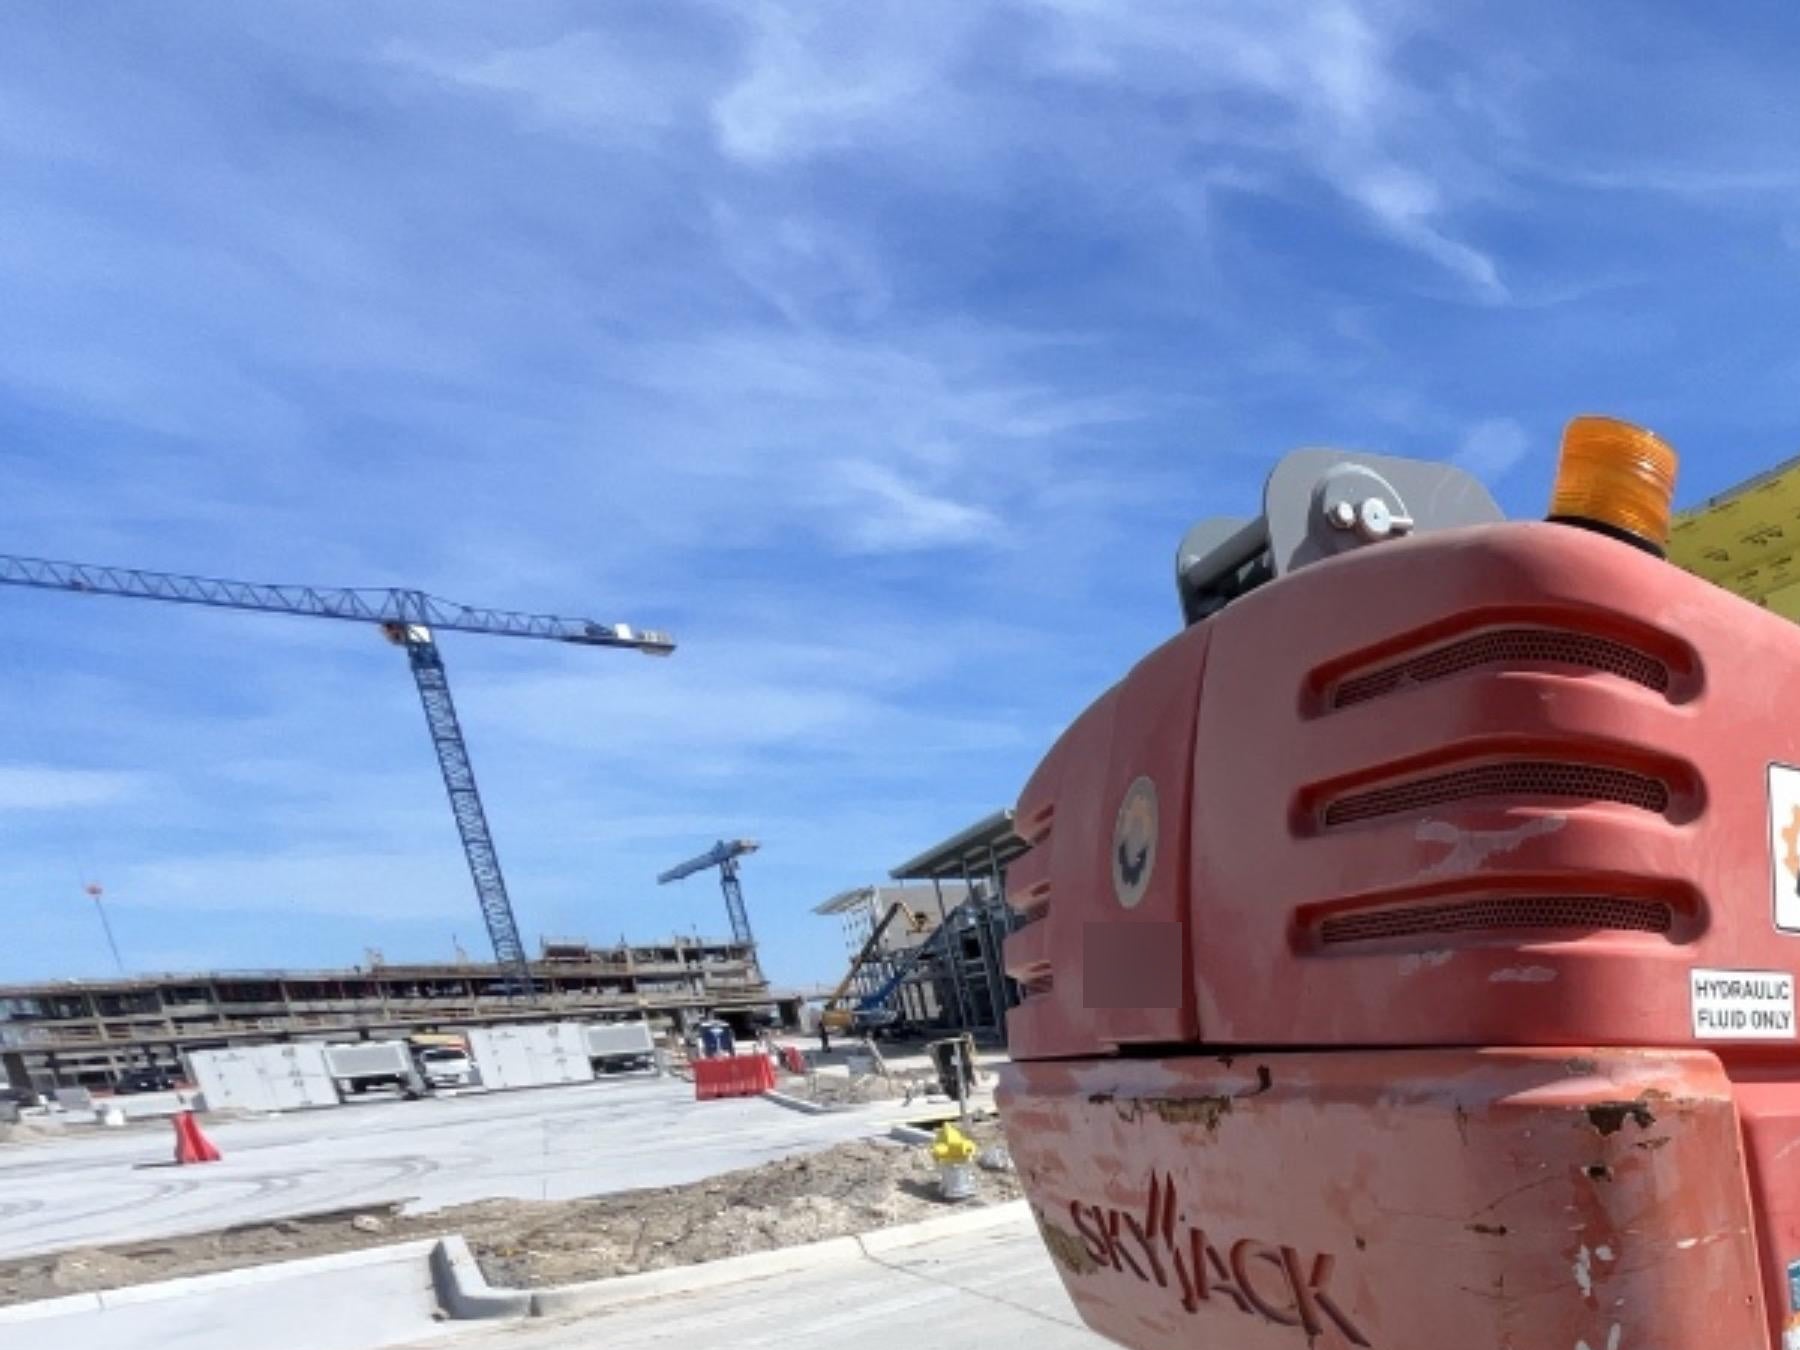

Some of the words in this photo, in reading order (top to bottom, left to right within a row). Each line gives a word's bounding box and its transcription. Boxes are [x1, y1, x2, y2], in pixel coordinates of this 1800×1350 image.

[1695, 978, 1789, 1000] HYDRAULIC
[1698, 1007, 1746, 1029] FLUID
[1751, 1009, 1791, 1029] ONLY
[1070, 1167, 1372, 1348] SKYJACK
